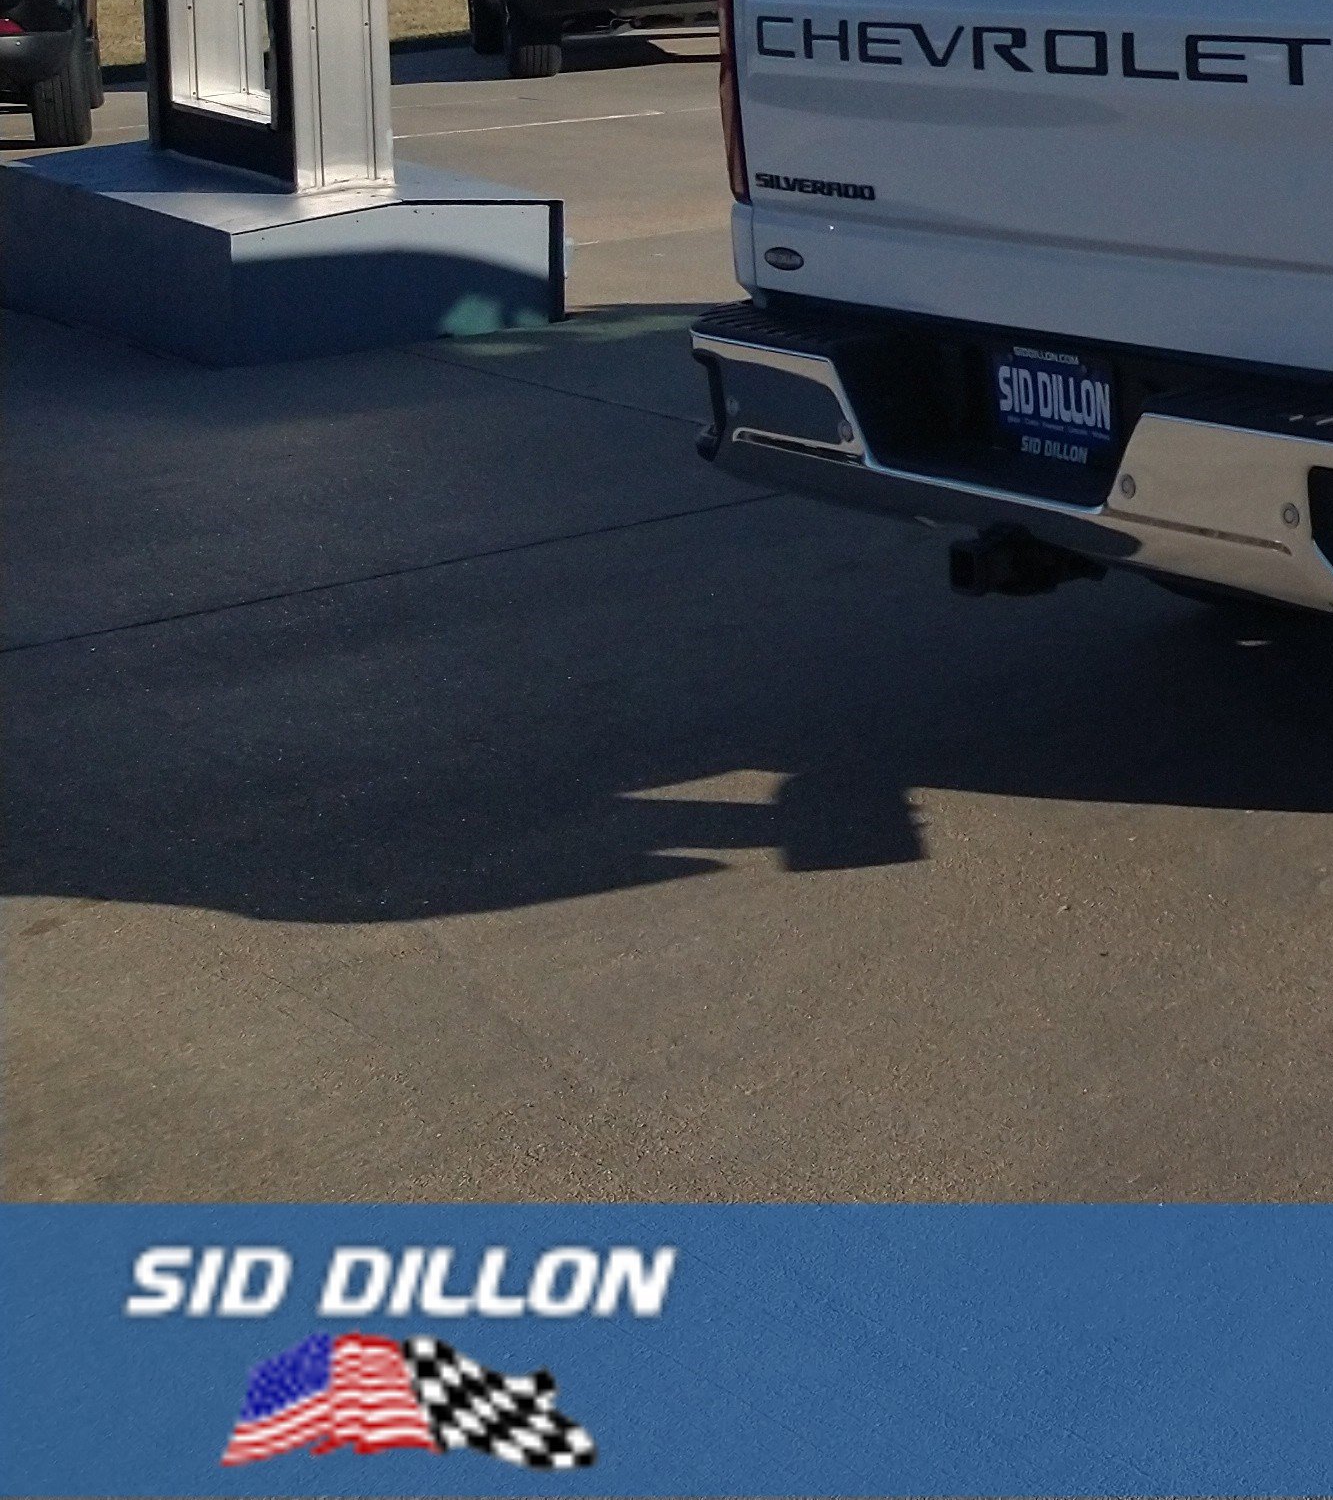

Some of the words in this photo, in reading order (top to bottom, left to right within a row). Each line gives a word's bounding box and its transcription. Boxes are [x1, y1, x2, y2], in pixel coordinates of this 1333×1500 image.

[756, 15, 1332, 86] CHEVROLET
[755, 172, 876, 200] SILVERADO
[998, 365, 1034, 415] SID
[1036, 371, 1111, 431] DILLON
[1021, 435, 1041, 455] SID
[1044, 440, 1089, 464] DILLON
